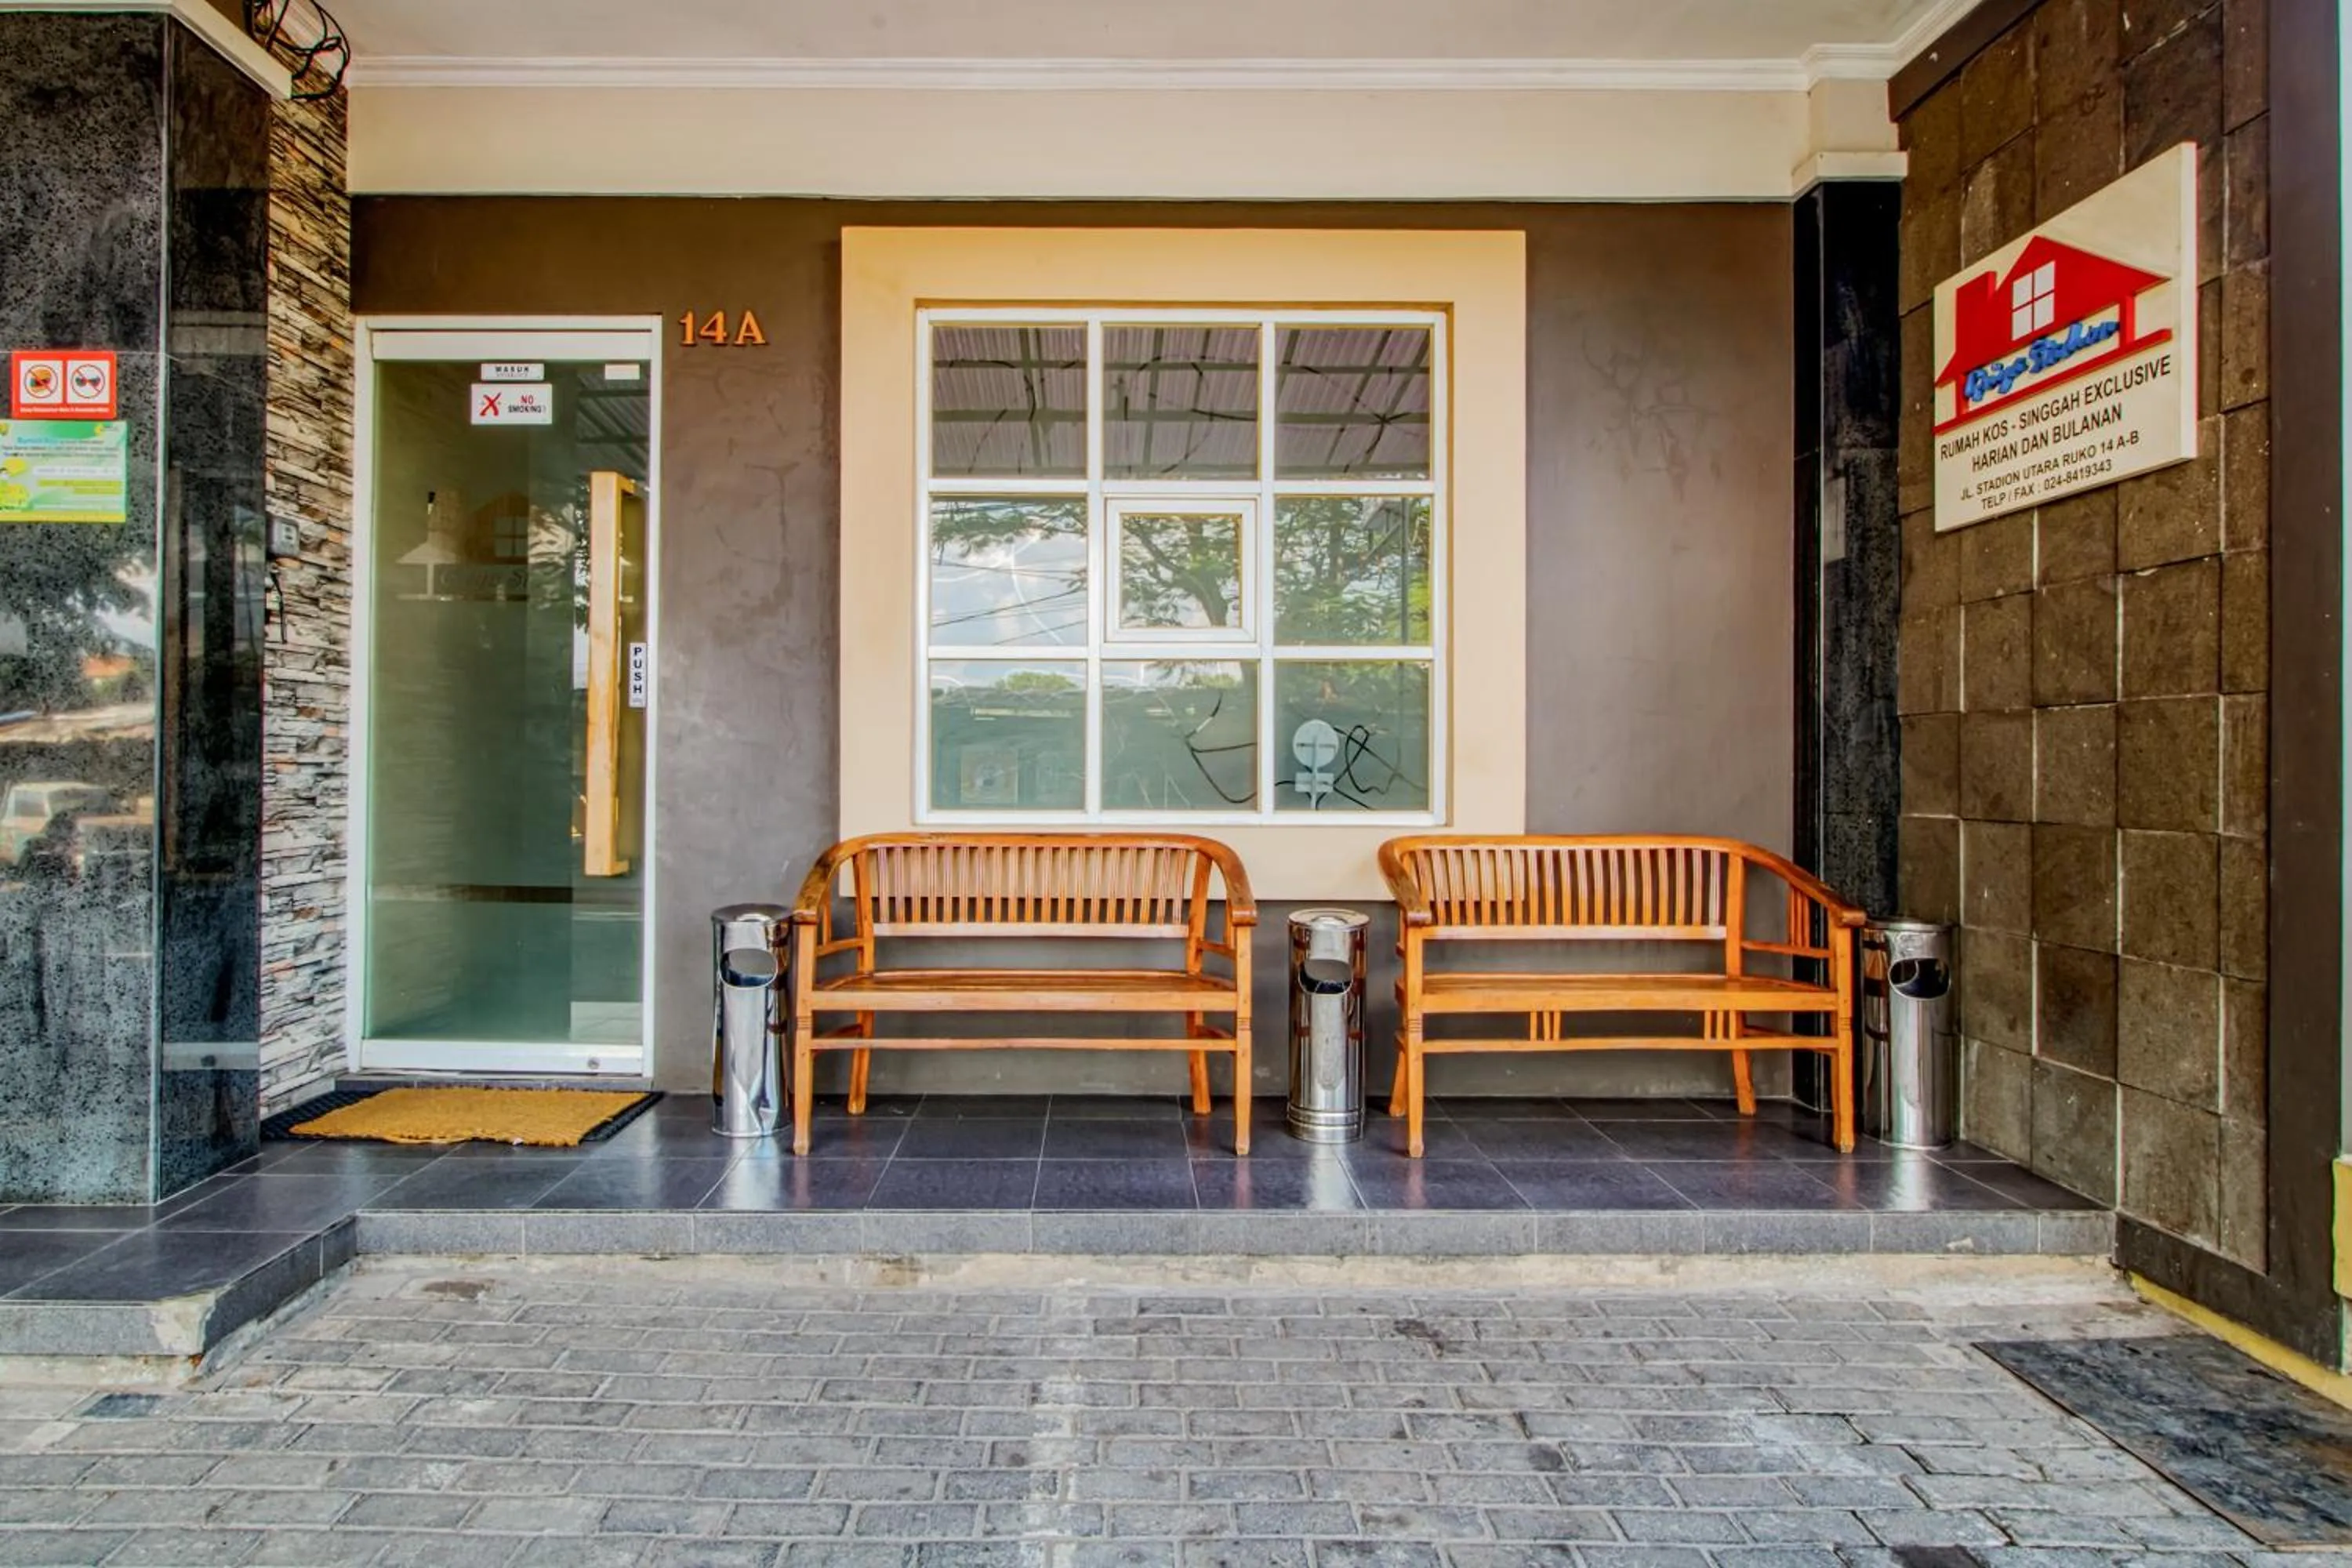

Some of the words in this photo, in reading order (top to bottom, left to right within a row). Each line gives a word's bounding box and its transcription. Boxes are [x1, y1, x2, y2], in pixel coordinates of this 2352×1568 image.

[521, 394, 534, 405] NO
[1940, 431, 1980, 461] RUMAH
[1983, 419, 2008, 445] KOS
[2019, 390, 2080, 430] SINGGAH
[2084, 354, 2171, 405] EXCLUSIVE
[1972, 441, 2017, 472] HARIAN
[2022, 430, 2049, 455] DAN
[2053, 402, 2122, 444] BULANAN
[1976, 470, 2020, 495] STADION
[2024, 458, 2060, 479] UTARA
[2063, 445, 2096, 467] RUKO
[2100, 438, 2113, 454] 14
[2116, 430, 2140, 449] A-B
[1982, 492, 2005, 510] TELP
[2014, 484, 2034, 501] FAX
[2044, 459, 2112, 490] 024-8419343
[633, 647, 642, 694] PUSH
